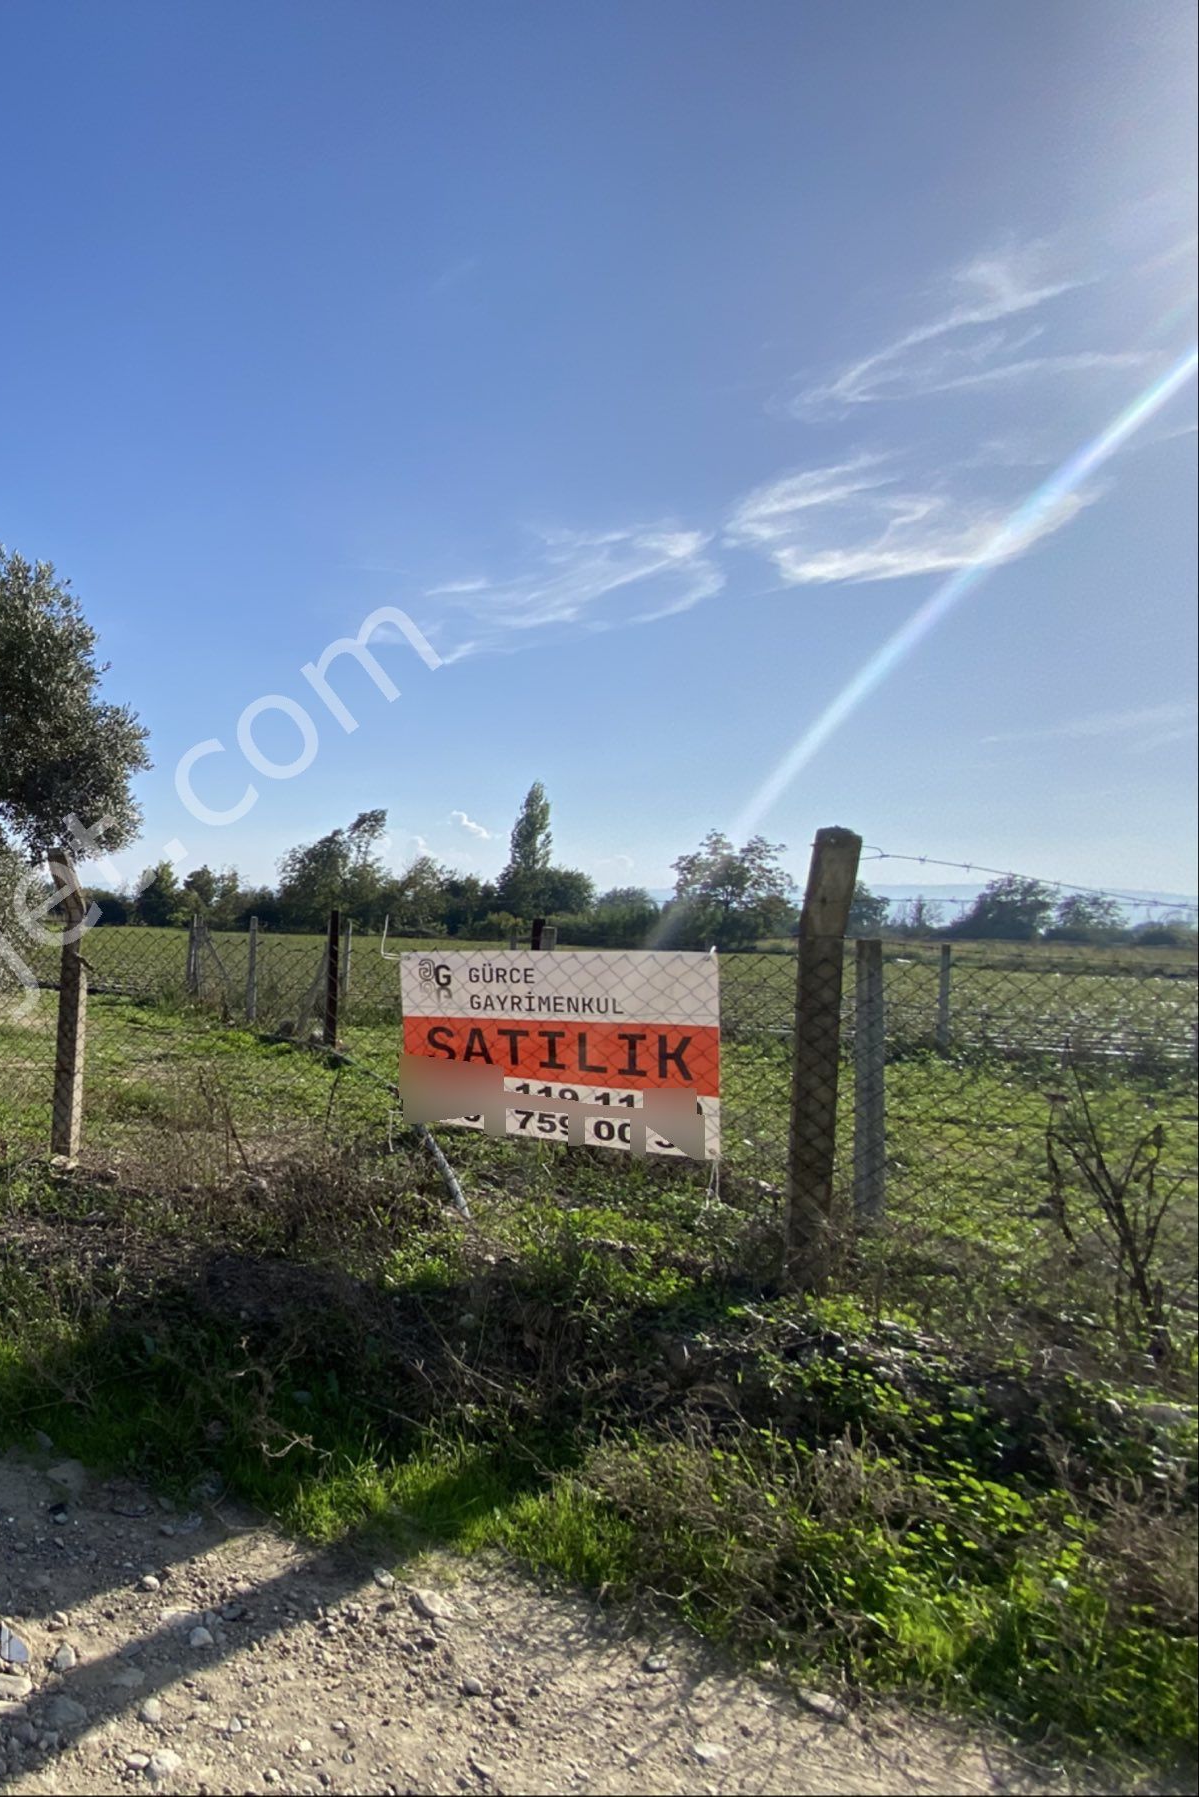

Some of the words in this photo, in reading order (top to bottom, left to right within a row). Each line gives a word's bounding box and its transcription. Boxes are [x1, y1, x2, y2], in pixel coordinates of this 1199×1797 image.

[468, 963, 536, 984] GÜRCE
[469, 991, 625, 1014] GAYRİMENKUL
[426, 1026, 694, 1081] SATILIK
